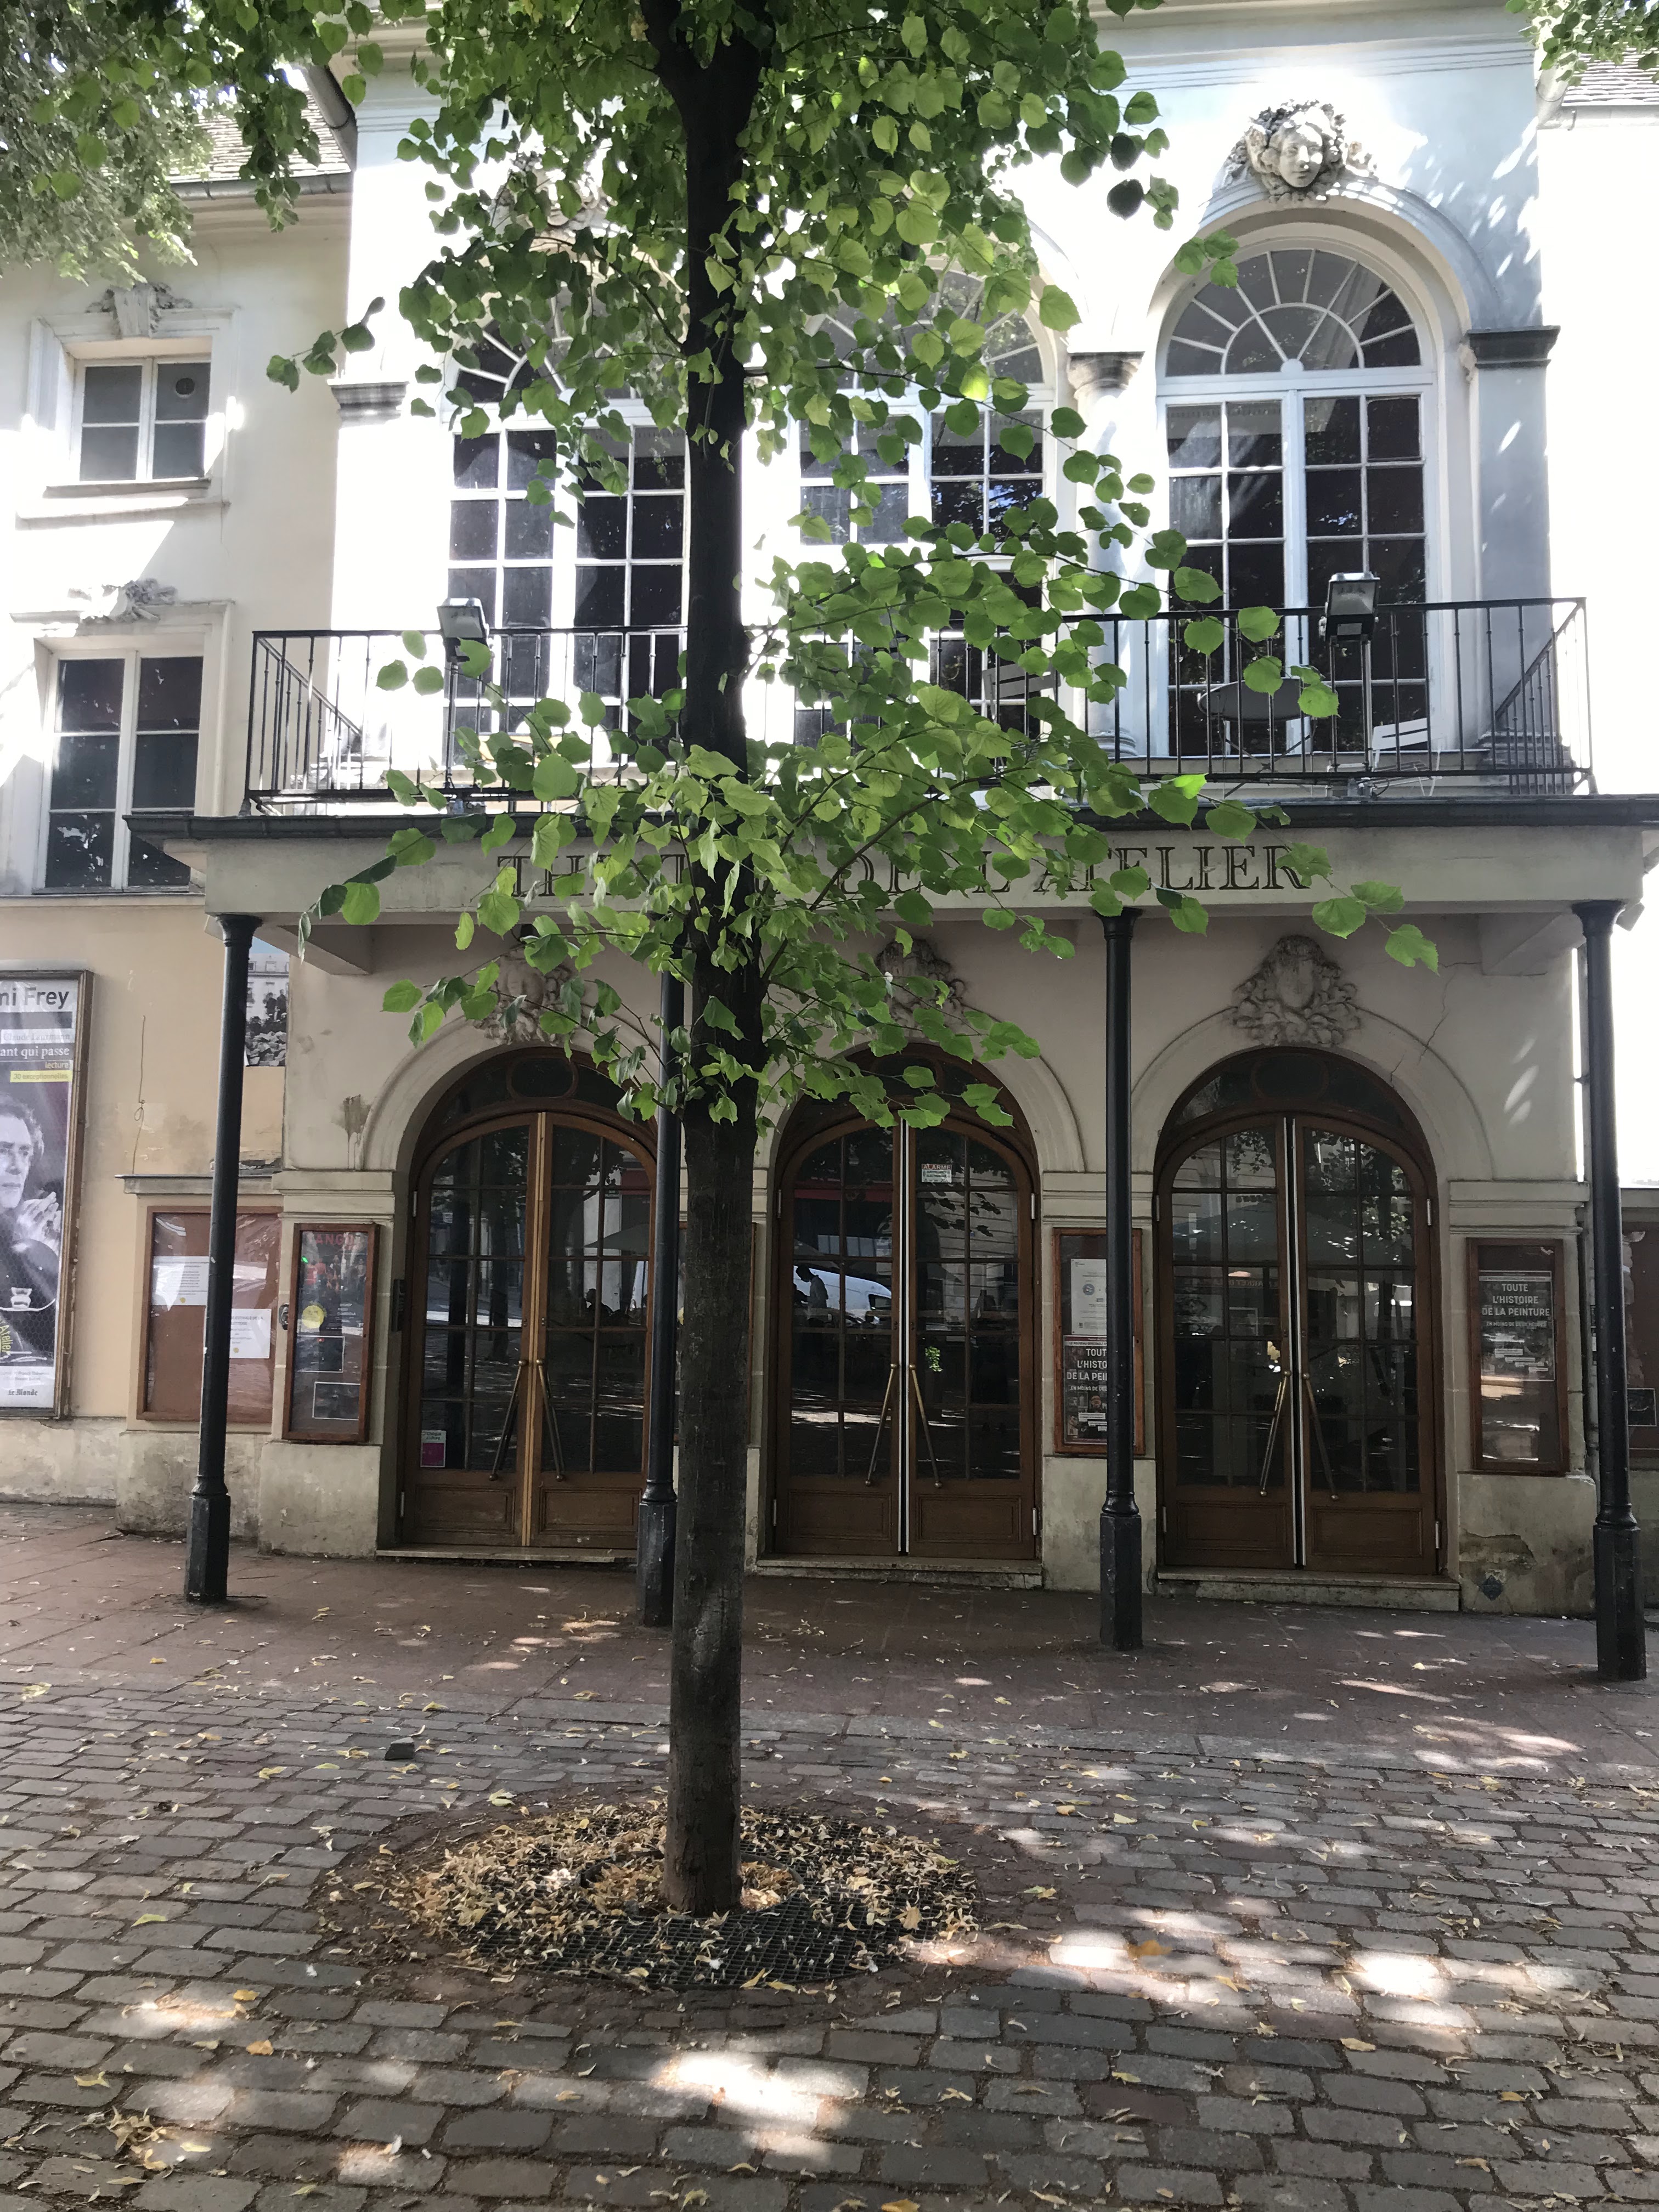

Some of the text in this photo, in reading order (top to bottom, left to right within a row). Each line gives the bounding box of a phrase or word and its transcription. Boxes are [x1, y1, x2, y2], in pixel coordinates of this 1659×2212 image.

[972, 845, 1311, 893] LELIER
[25, 987, 69, 1009] Frey
[21, 1046, 38, 1059] qui
[42, 1047, 70, 1059] passe
[1493, 1296, 1539, 1304] L'HISTOIRE
[1482, 1307, 1550, 1316] DE LA PEINTURE
[1086, 1348, 1107, 1357] TOUT
[1077, 1360, 1107, 1368] L'HISTO
[1079, 1372, 1090, 1380] LA
